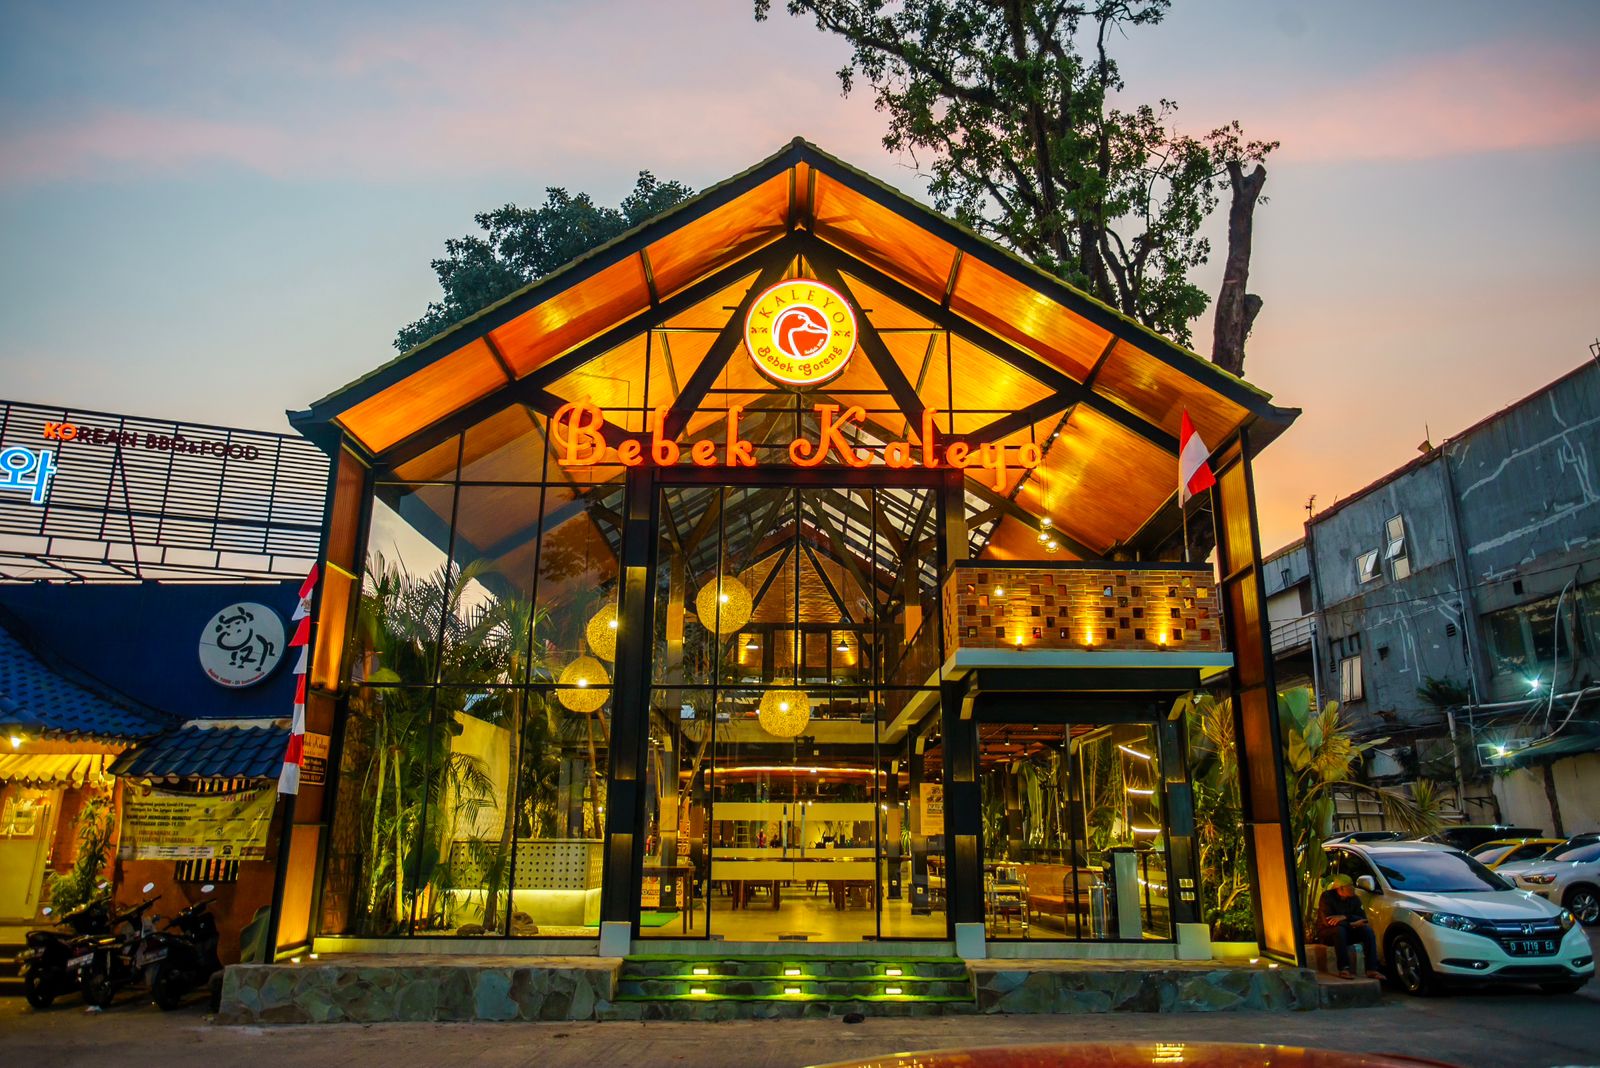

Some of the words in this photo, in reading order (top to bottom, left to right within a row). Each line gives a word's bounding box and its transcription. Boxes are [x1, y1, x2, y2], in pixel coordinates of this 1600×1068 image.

[758, 288, 845, 323] KALEYO
[757, 345, 793, 373] Bebek
[798, 345, 843, 376] Goreng
[43, 421, 138, 448] KOREAN
[552, 400, 757, 467] Bebek
[789, 403, 1042, 493] Kaleyo
[0, 446, 57, 504] 와
